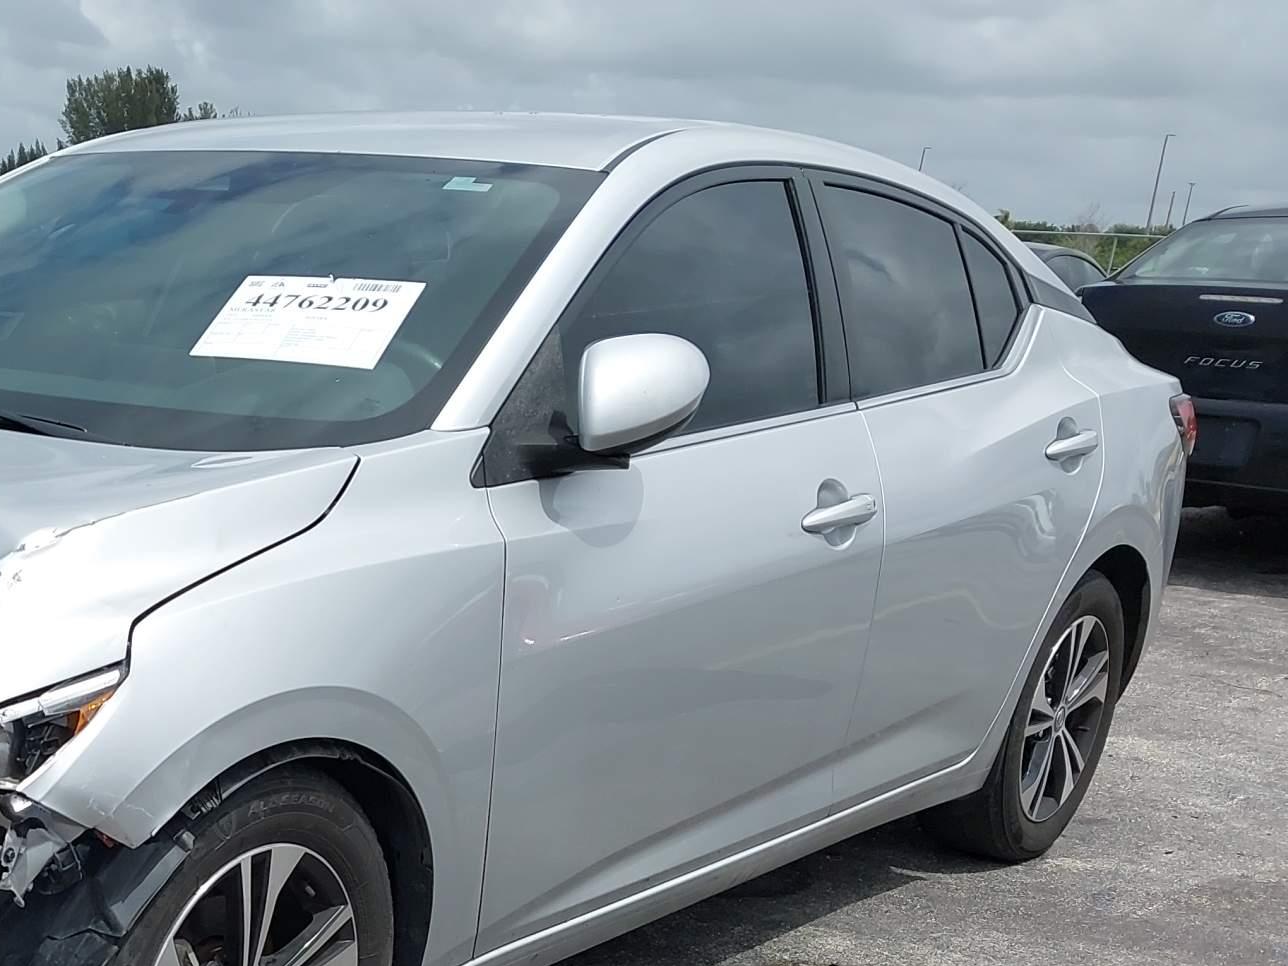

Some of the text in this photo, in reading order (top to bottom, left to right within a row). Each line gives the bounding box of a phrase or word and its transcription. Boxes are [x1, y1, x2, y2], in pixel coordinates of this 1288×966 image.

[245, 293, 389, 313] 44762209
[1222, 312, 1246, 324] Ford
[1183, 355, 1264, 370] FOCUS
